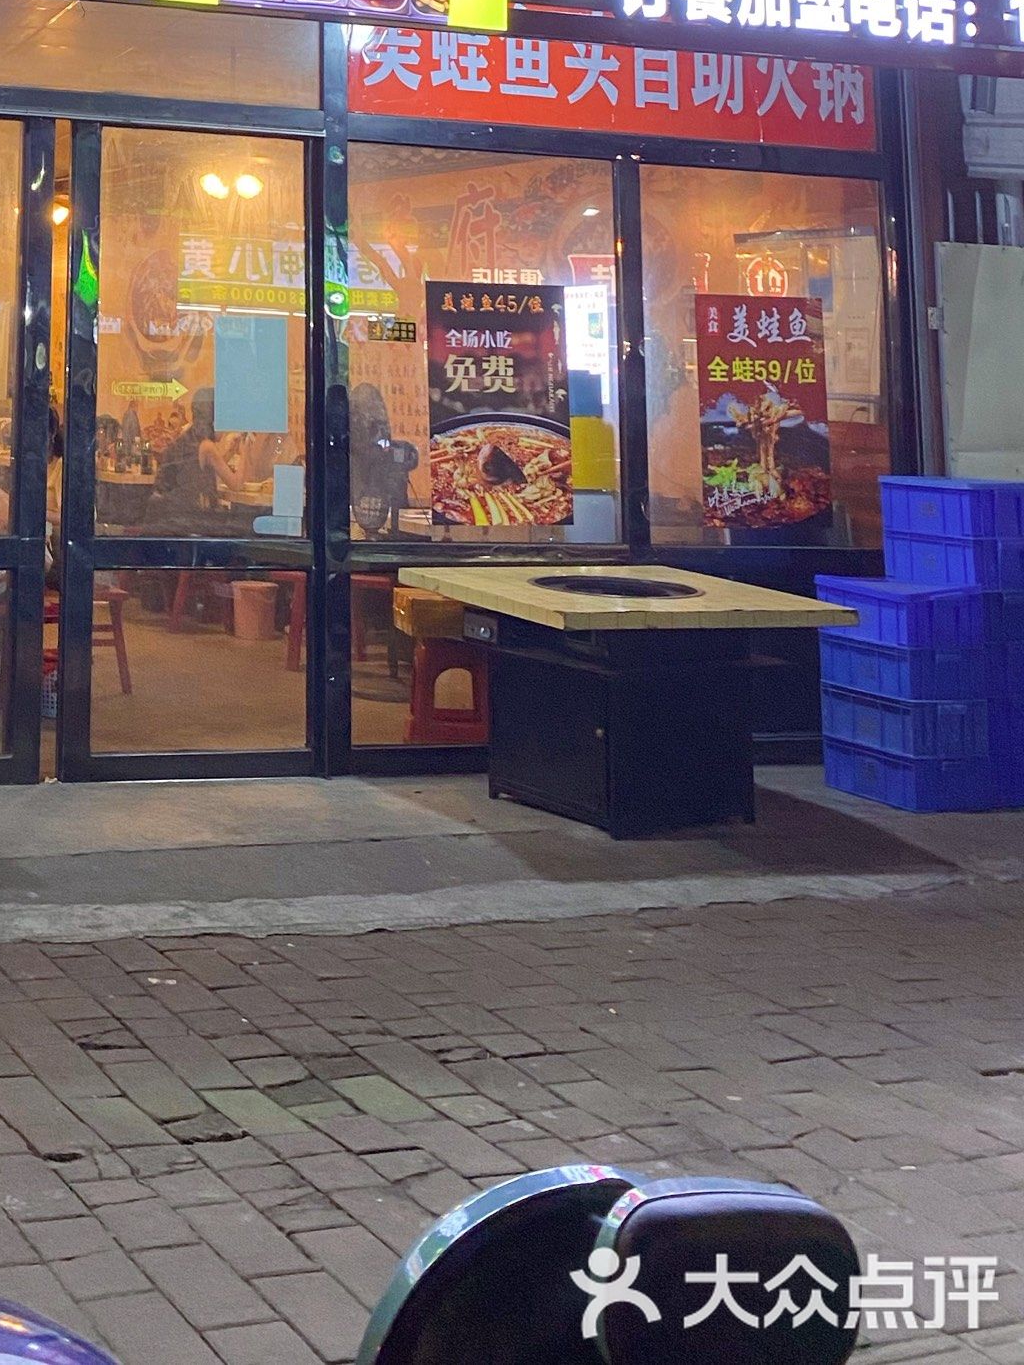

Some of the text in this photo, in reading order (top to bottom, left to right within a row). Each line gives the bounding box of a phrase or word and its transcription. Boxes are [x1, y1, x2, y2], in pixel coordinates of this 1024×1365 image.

[445, 329, 513, 349] 全场小吃
[727, 304, 812, 347] 美蛙鱼
[444, 354, 517, 393] 免费
[707, 356, 816, 384] 全蛙59/位
